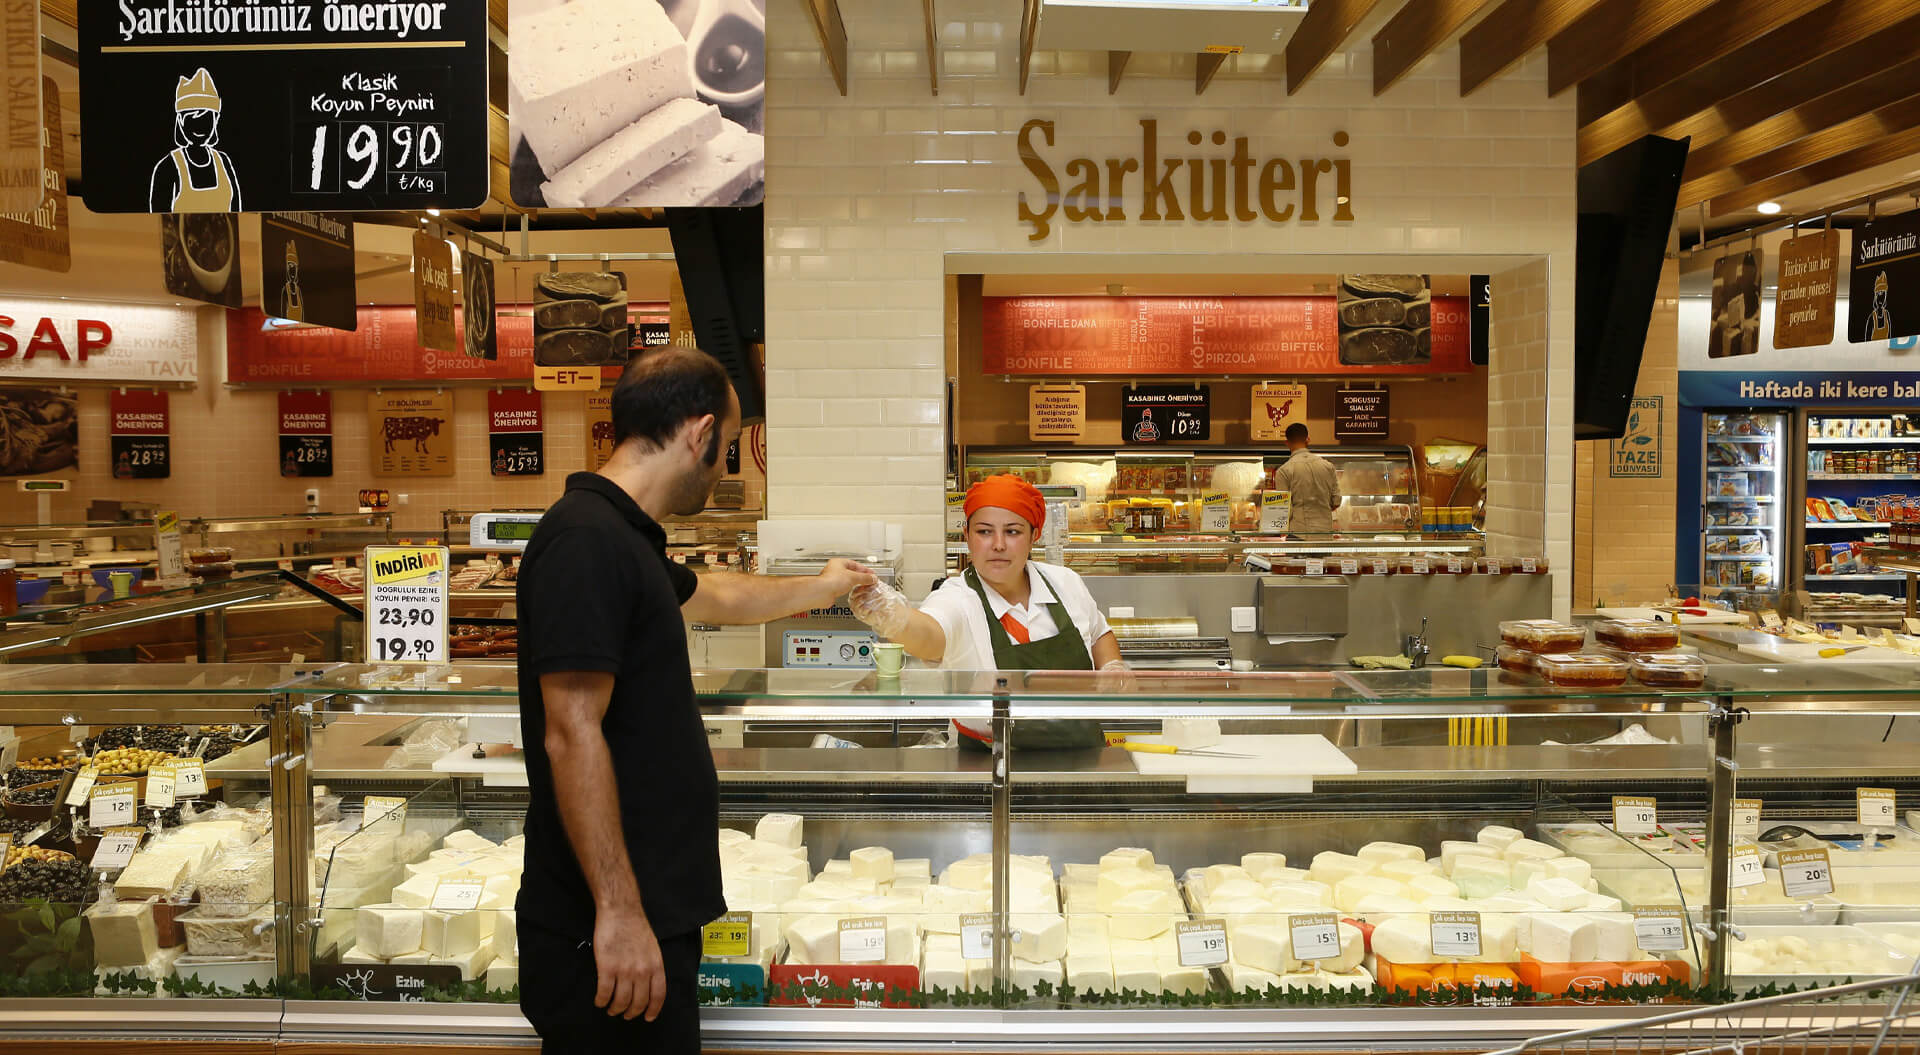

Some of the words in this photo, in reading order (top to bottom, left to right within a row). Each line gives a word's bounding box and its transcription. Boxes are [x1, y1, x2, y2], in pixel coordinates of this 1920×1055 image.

[119, 0, 311, 41] Şarkütörünüz
[323, 0, 446, 37] öneriyor
[342, 72, 398, 91] Klasik
[9, 76, 39, 149] SALAM
[311, 92, 364, 118] Koyun
[370, 92, 435, 117] Peyniri
[1017, 119, 1354, 241] Şarküteri
[1860, 233, 1917, 263] Şarkütörünüz
[1820, 252, 1831, 273] her
[421, 257, 433, 286] Çok
[434, 267, 448, 290] çeşit
[1071, 319, 1097, 328] DANA
[557, 371, 579, 385] ET
[1168, 393, 1203, 402] ÖNERİYOR
[1740, 381, 1813, 398] Haftada
[1820, 381, 1841, 398] iki
[1848, 381, 1888, 398] kere
[494, 410, 537, 418] KASABINIZ
[494, 418, 538, 427] ÖNERİYOR
[116, 420, 164, 429] ÖNERİYOR
[1616, 451, 1656, 463] TAZE
[375, 552, 438, 577] İNDİRİM
[379, 607, 434, 628] 23,90
[1203, 939, 1217, 949] 19
